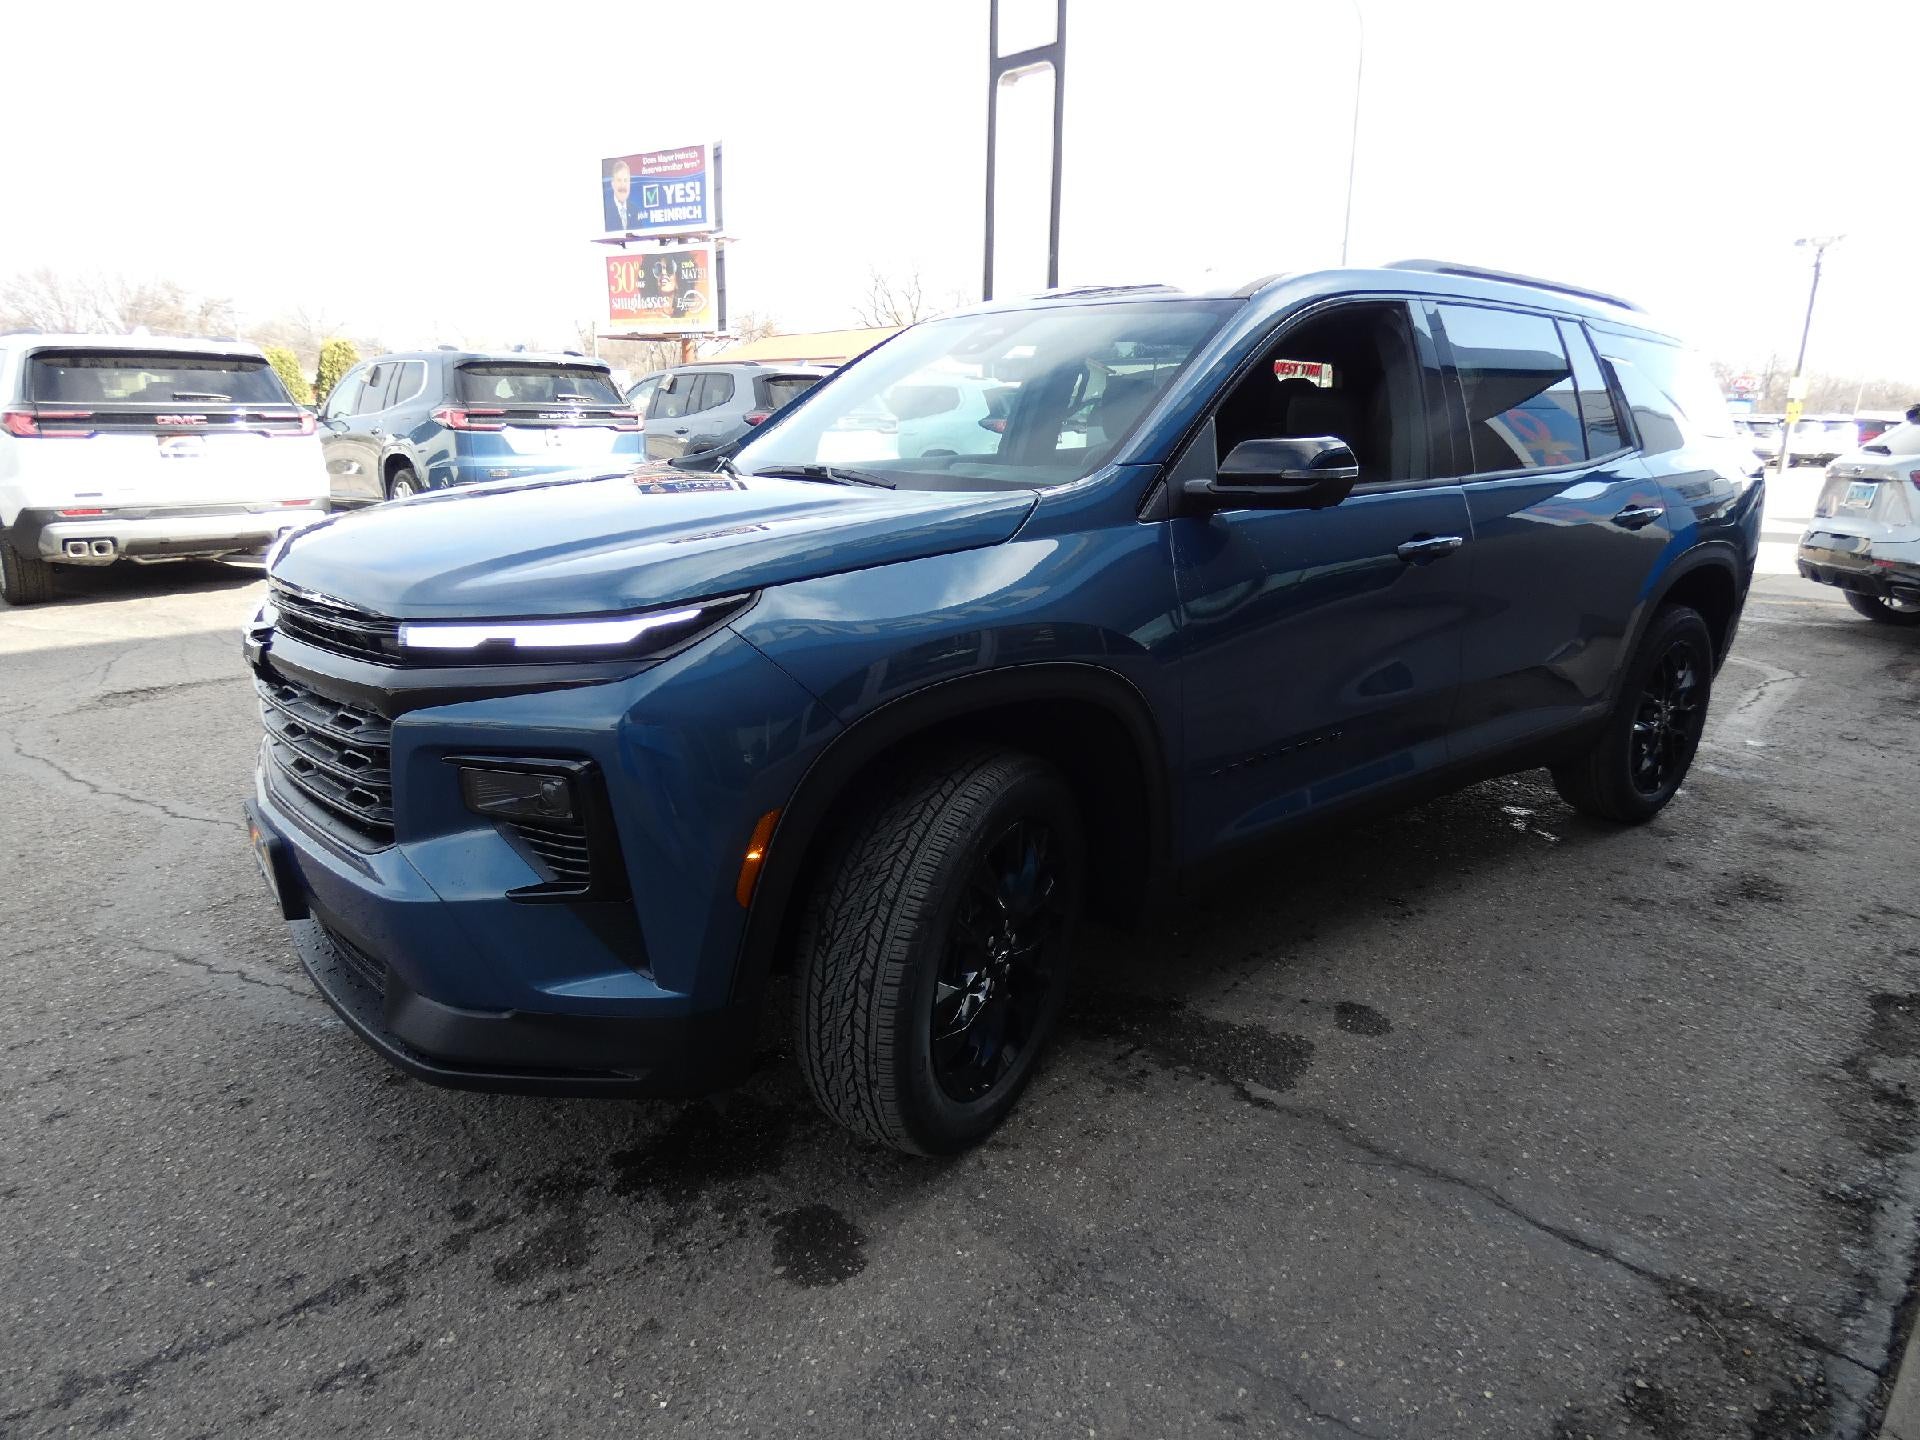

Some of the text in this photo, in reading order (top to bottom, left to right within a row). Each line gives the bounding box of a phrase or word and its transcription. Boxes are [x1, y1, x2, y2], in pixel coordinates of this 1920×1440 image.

[663, 181, 701, 205] YES!
[650, 205, 702, 223] HEINRICH
[681, 268, 697, 280] MAY
[612, 293, 670, 312] sunglasses
[155, 414, 208, 425] GMC
